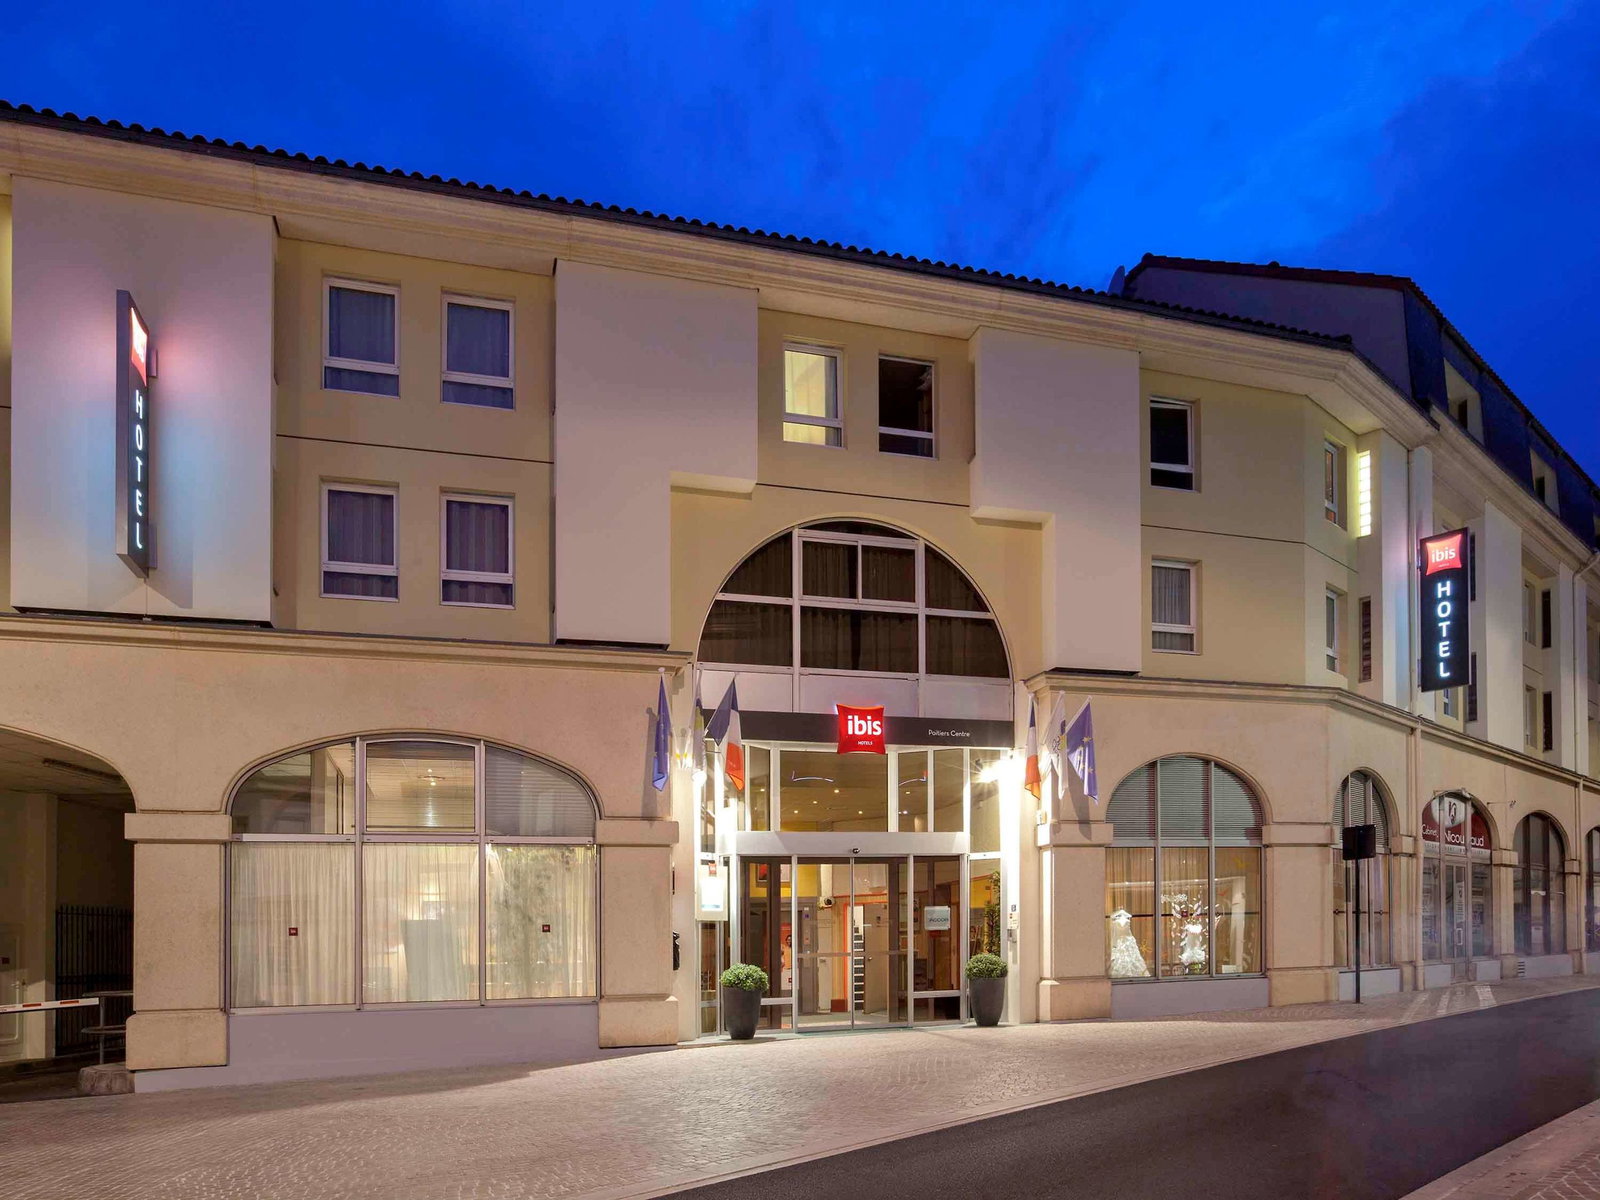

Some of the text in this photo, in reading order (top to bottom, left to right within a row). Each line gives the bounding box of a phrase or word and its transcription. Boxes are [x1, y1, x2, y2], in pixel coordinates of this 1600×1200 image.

[135, 389, 143, 549] HOTEL
[1432, 547, 1456, 563] ibis
[1437, 581, 1451, 677] HOTEL
[847, 715, 882, 735] ibis
